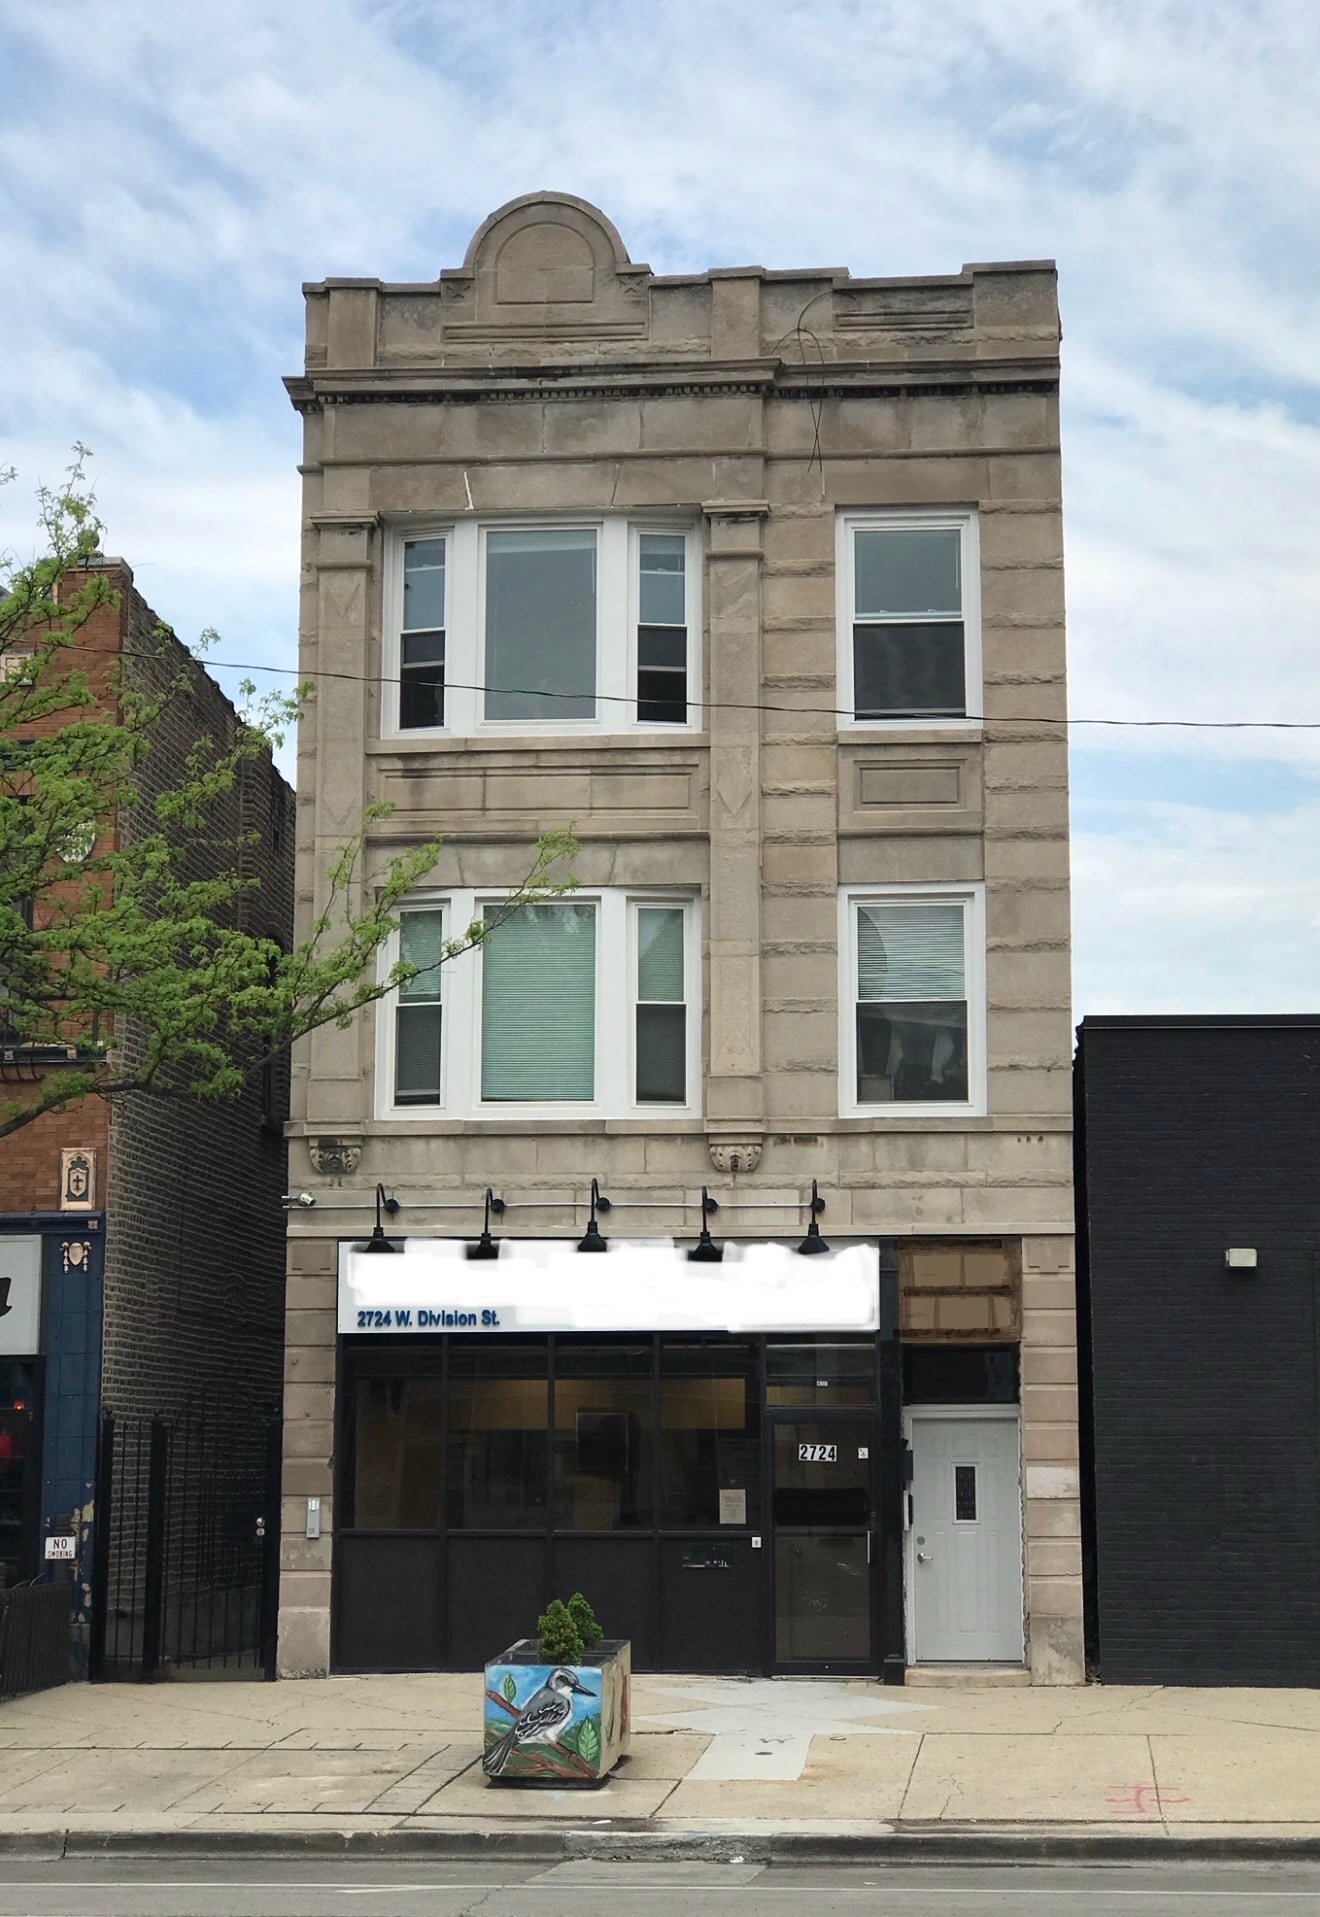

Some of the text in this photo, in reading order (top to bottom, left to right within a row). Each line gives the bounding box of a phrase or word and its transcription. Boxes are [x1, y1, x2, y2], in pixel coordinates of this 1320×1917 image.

[357, 1309, 500, 1327] 2724 W. Division St.
[800, 1445, 836, 1461] 2724
[53, 1538, 68, 1550] NO
